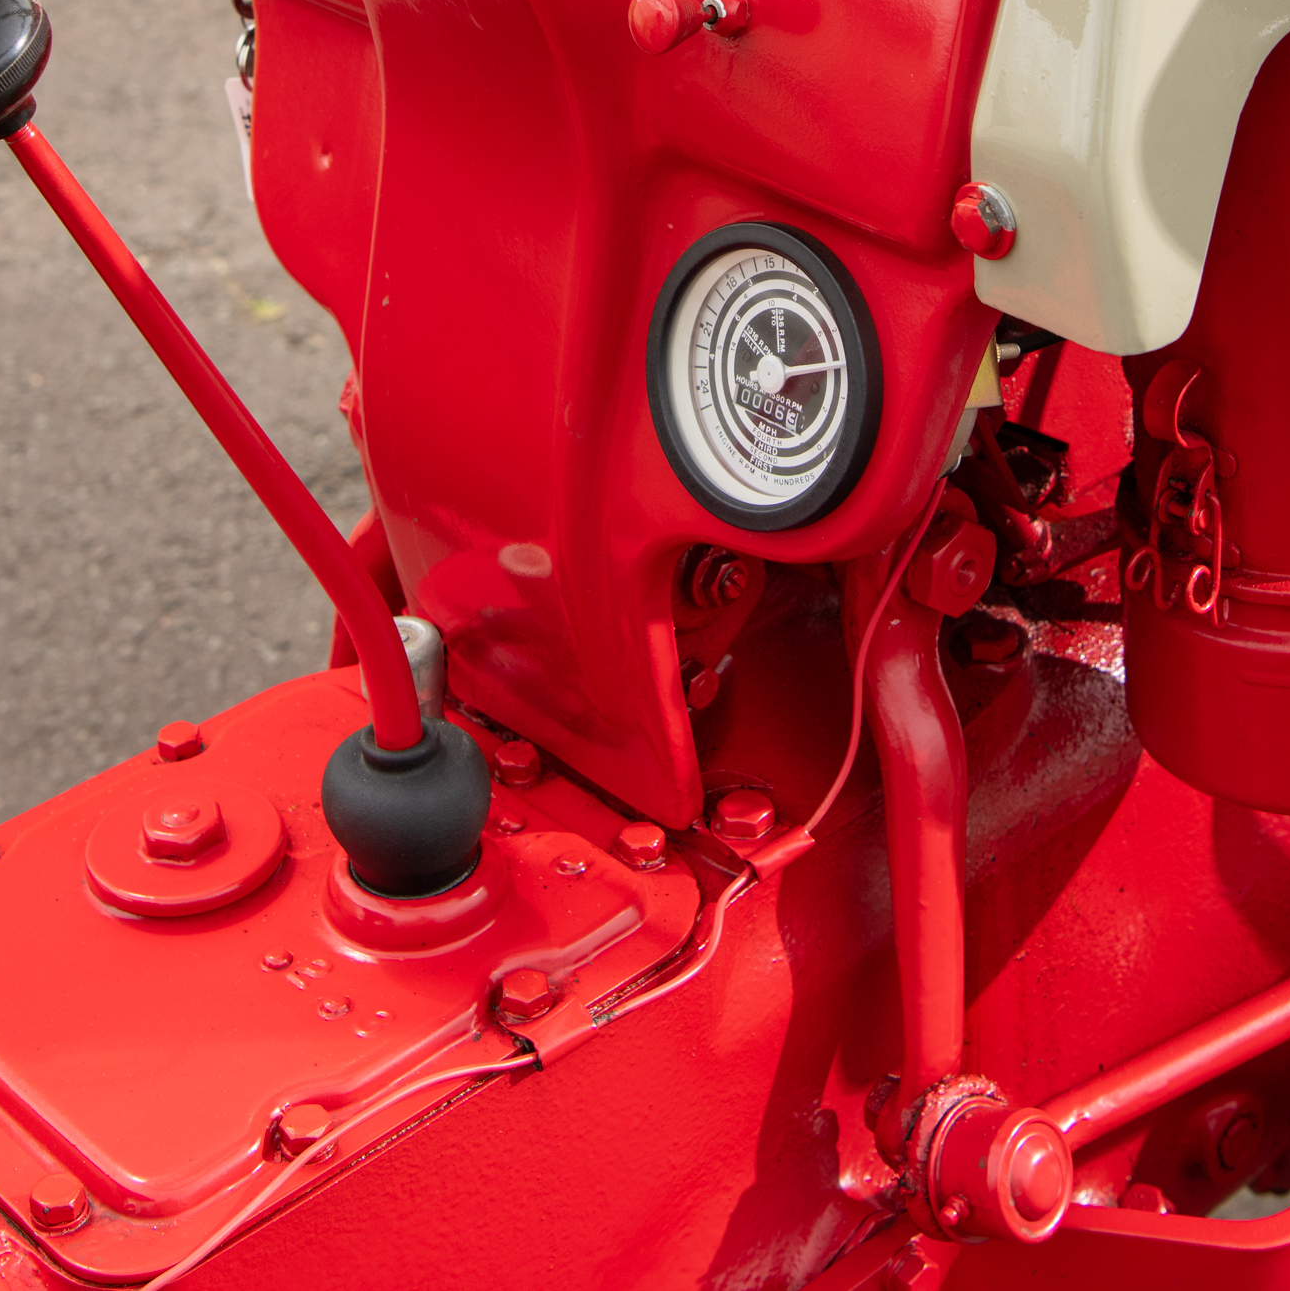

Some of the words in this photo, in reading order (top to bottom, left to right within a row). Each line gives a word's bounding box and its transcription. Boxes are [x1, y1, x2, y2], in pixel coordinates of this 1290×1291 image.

[764, 257, 775, 269] 15
[726, 276, 737, 290] 18
[747, 278, 753, 287] 3
[791, 283, 796, 291] 3
[792, 293, 798, 302] 4
[812, 287, 819, 296] 2
[768, 299, 776, 307] 10
[703, 321, 713, 338] 21
[746, 325, 759, 341] 1316
[731, 341, 736, 351] 14
[741, 332, 761, 356] PULLEY
[709, 353, 715, 361] 4
[700, 379, 709, 395] 24
[735, 374, 759, 391] HOURS
[769, 393, 785, 404] 1580
[752, 427, 783, 446] FOURTH
[758, 421, 777, 437] MPH
[753, 437, 778, 456] THIRD
[715, 425, 737, 458] ENGINE
[760, 473, 769, 482] IN
[773, 472, 815, 486] HUNDREDS
[749, 445, 778, 465] SECOND
[750, 455, 773, 473] FIRST
